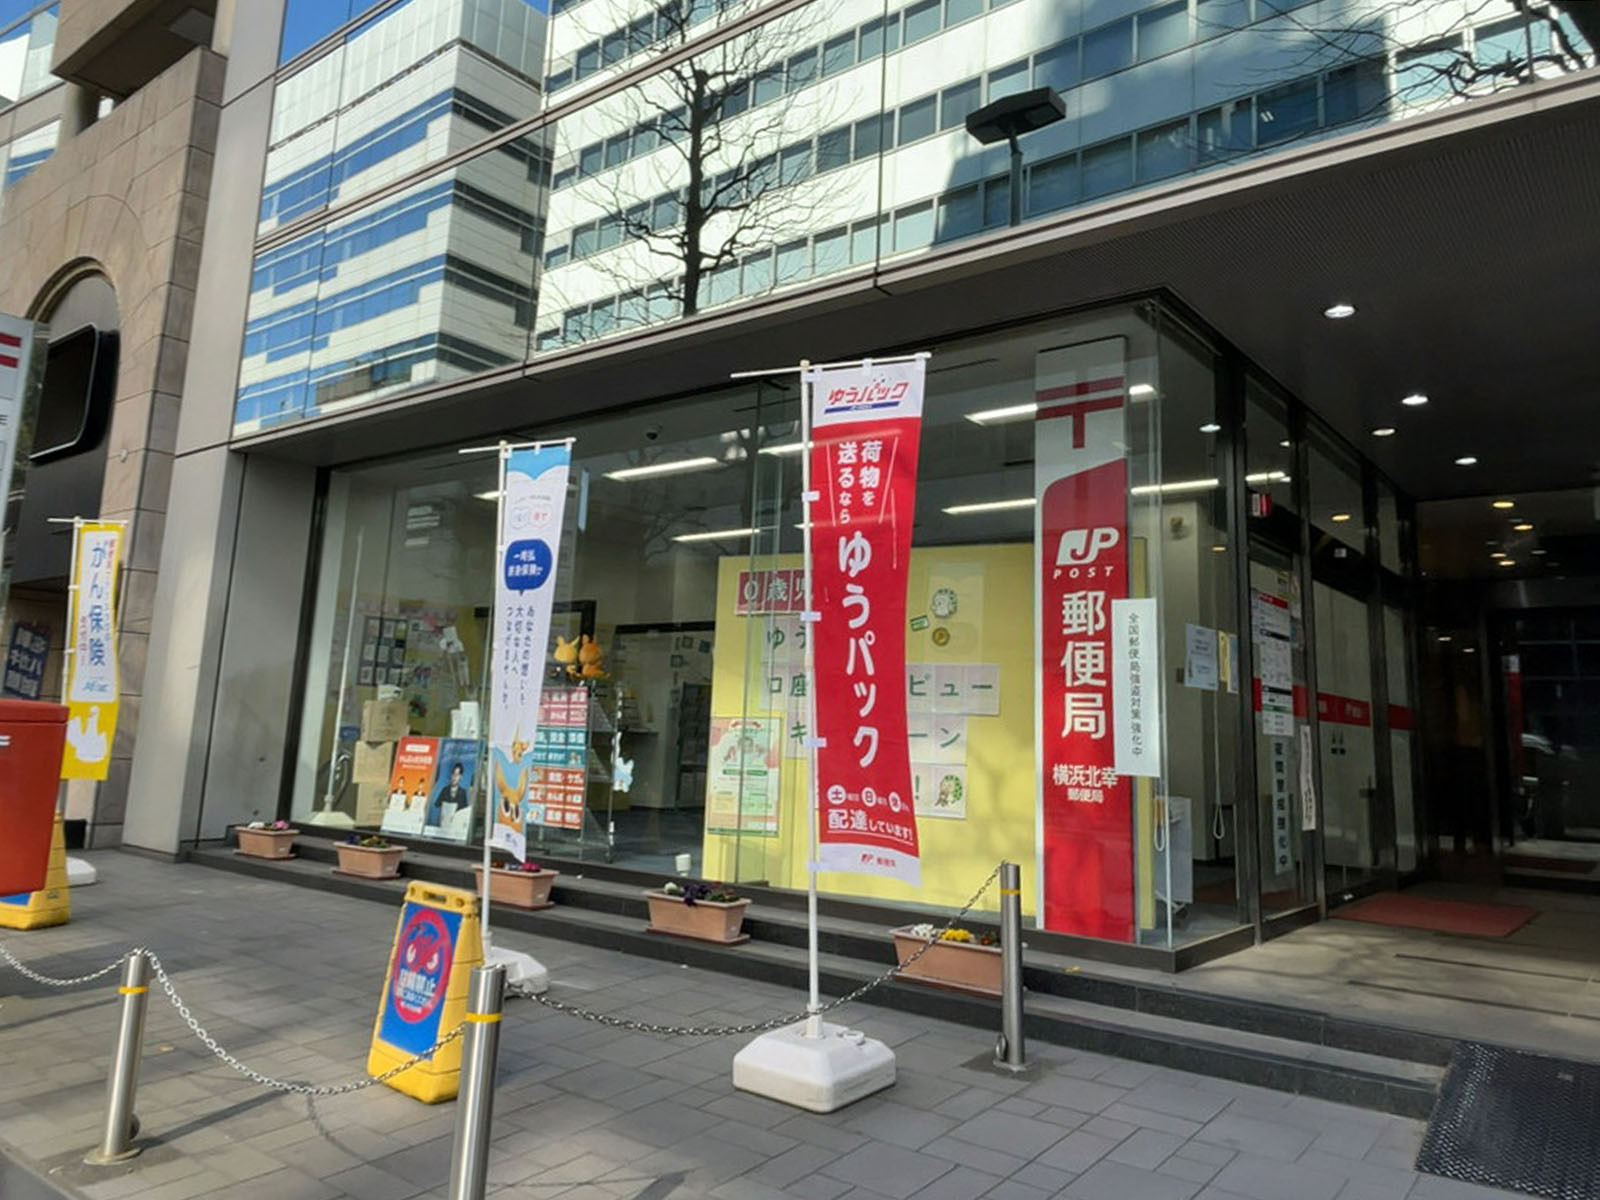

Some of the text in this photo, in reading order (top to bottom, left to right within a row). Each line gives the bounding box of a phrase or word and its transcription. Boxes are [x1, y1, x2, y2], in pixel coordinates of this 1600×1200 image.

[828, 381, 910, 404] ゆうパック
[838, 441, 858, 524] 送るなら
[860, 440, 882, 506] 荷物を
[88, 541, 107, 667] がん保険
[1053, 566, 1115, 580] POST
[839, 531, 879, 768] ゆうパック
[1061, 590, 1107, 740] 郵便局
[909, 673, 993, 697] ビュー
[1053, 763, 1118, 788] 横浜北幸
